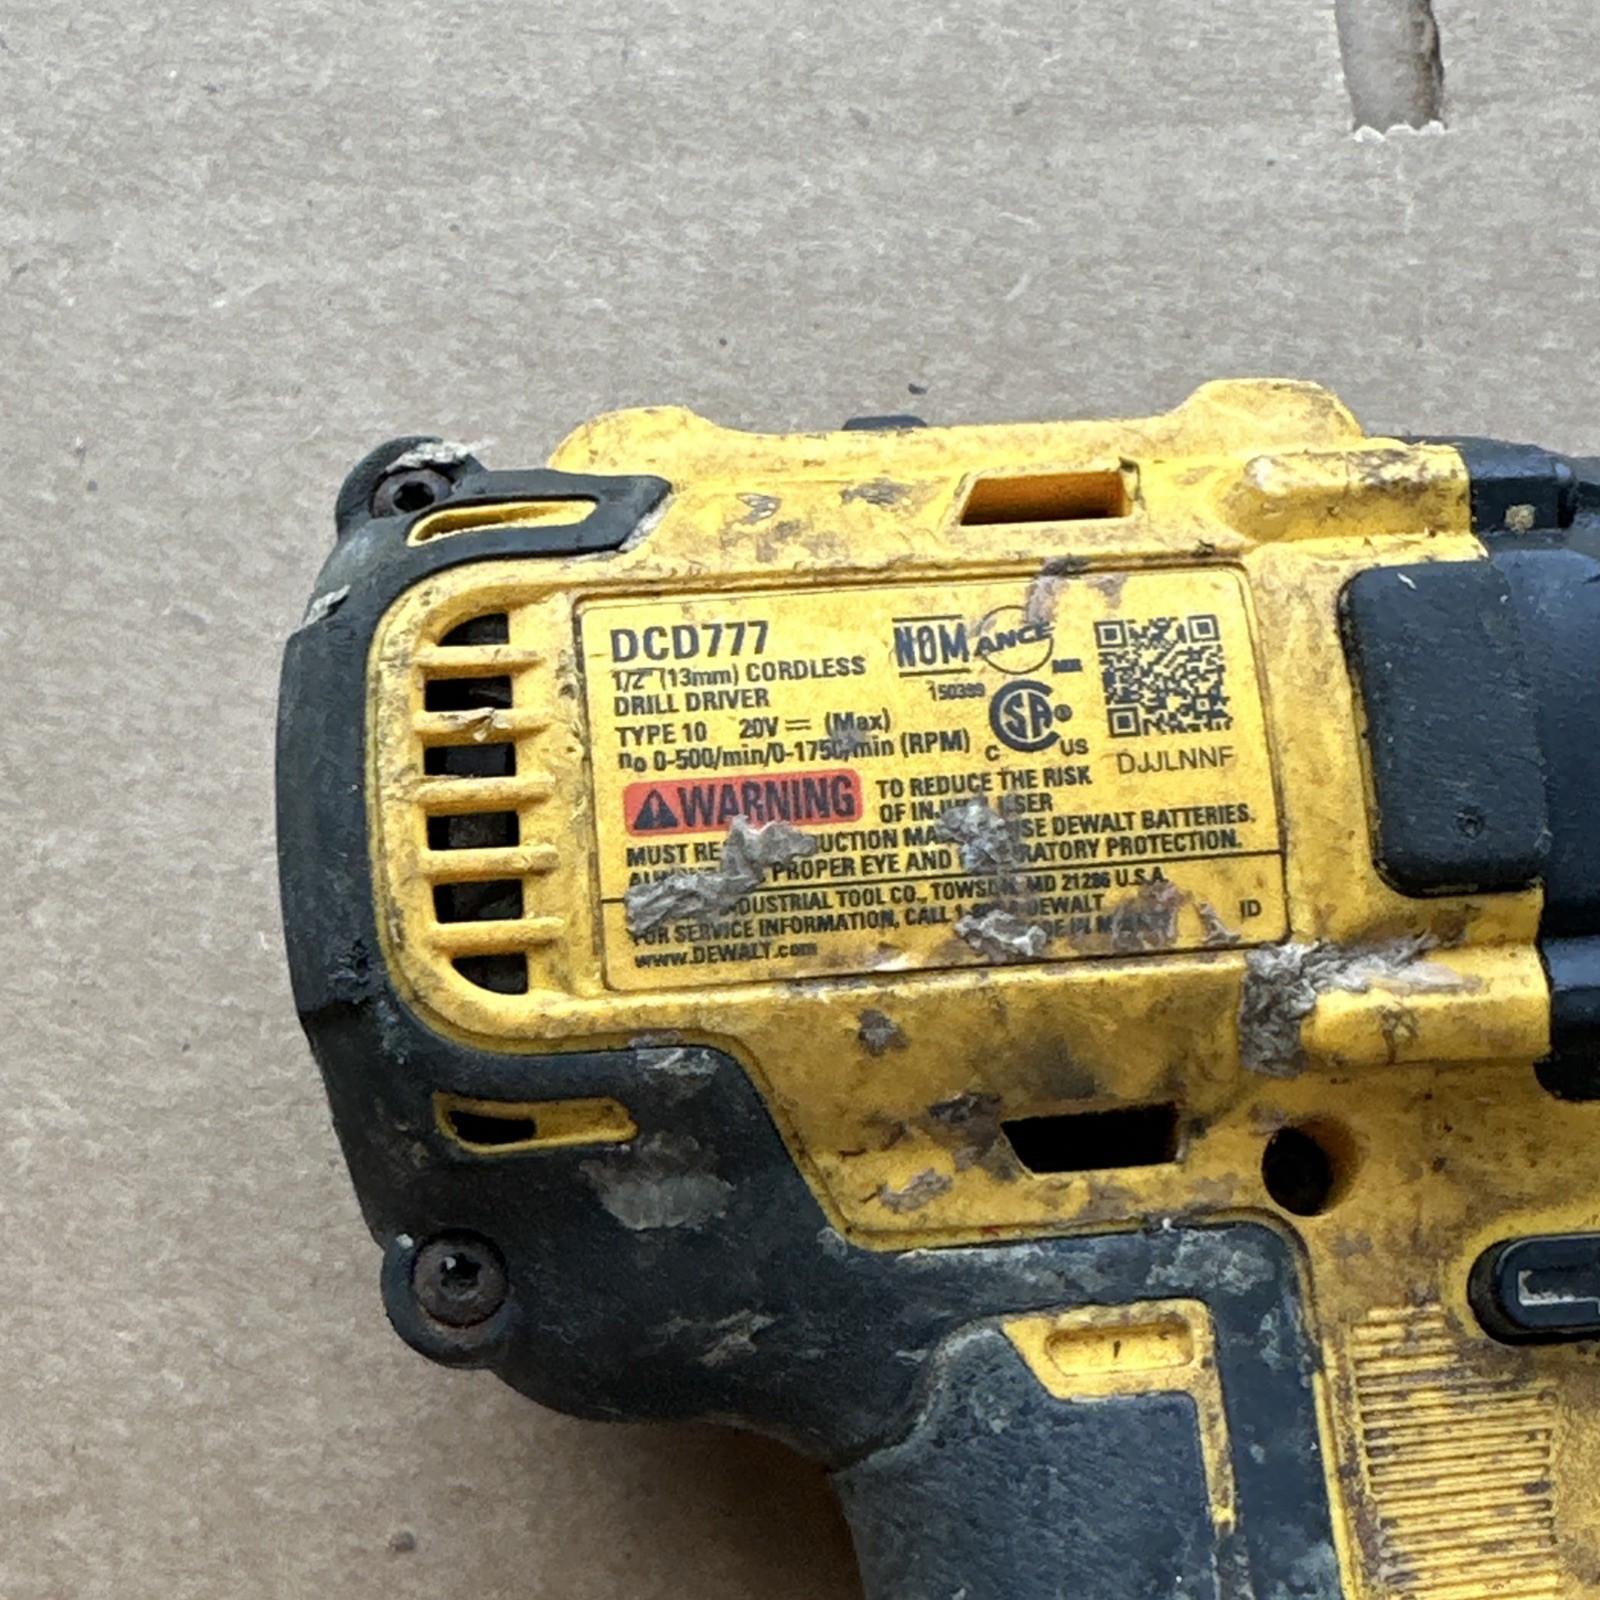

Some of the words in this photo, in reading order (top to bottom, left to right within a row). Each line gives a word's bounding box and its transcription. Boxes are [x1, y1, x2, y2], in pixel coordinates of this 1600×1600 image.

[610, 621, 768, 663] DCD777
[974, 621, 1055, 657] ANCE
[660, 663, 739, 691] (13mm)
[746, 656, 867, 682] CORDLESS
[613, 694, 679, 717] DRILL
[686, 688, 770, 711] DRIVER
[615, 723, 676, 747] TYPE
[682, 721, 707, 743] 10
[738, 716, 779, 739] 20V
[825, 706, 891, 737] (Max)
[901, 727, 970, 758] (RPM)
[1060, 739, 1089, 756] US
[1117, 745, 1234, 775] DJJLNNF
[875, 778, 904, 799] TO
[910, 772, 993, 797] REDUCE
[997, 769, 1038, 791] THE
[1042, 766, 1092, 788] RISK
[677, 774, 856, 828] WARNING
[880, 802, 907, 824] OF
[626, 843, 689, 868] MUST
[1053, 811, 1136, 836] DEWALT
[1142, 803, 1256, 829] BATTERIES.
[772, 856, 857, 882] PROPER
[861, 853, 901, 876] EYE
[906, 849, 952, 872] AND
[1106, 829, 1243, 857] PROTECTION.
[836, 886, 886, 908] TOOL
[1026, 873, 1056, 893] MD
[674, 920, 758, 943] SERVICE
[759, 909, 900, 938] INFORMATION,
[904, 905, 952, 926] CALL
[1239, 899, 1262, 918] ID
[634, 941, 818, 969] www.DEWALT.com
